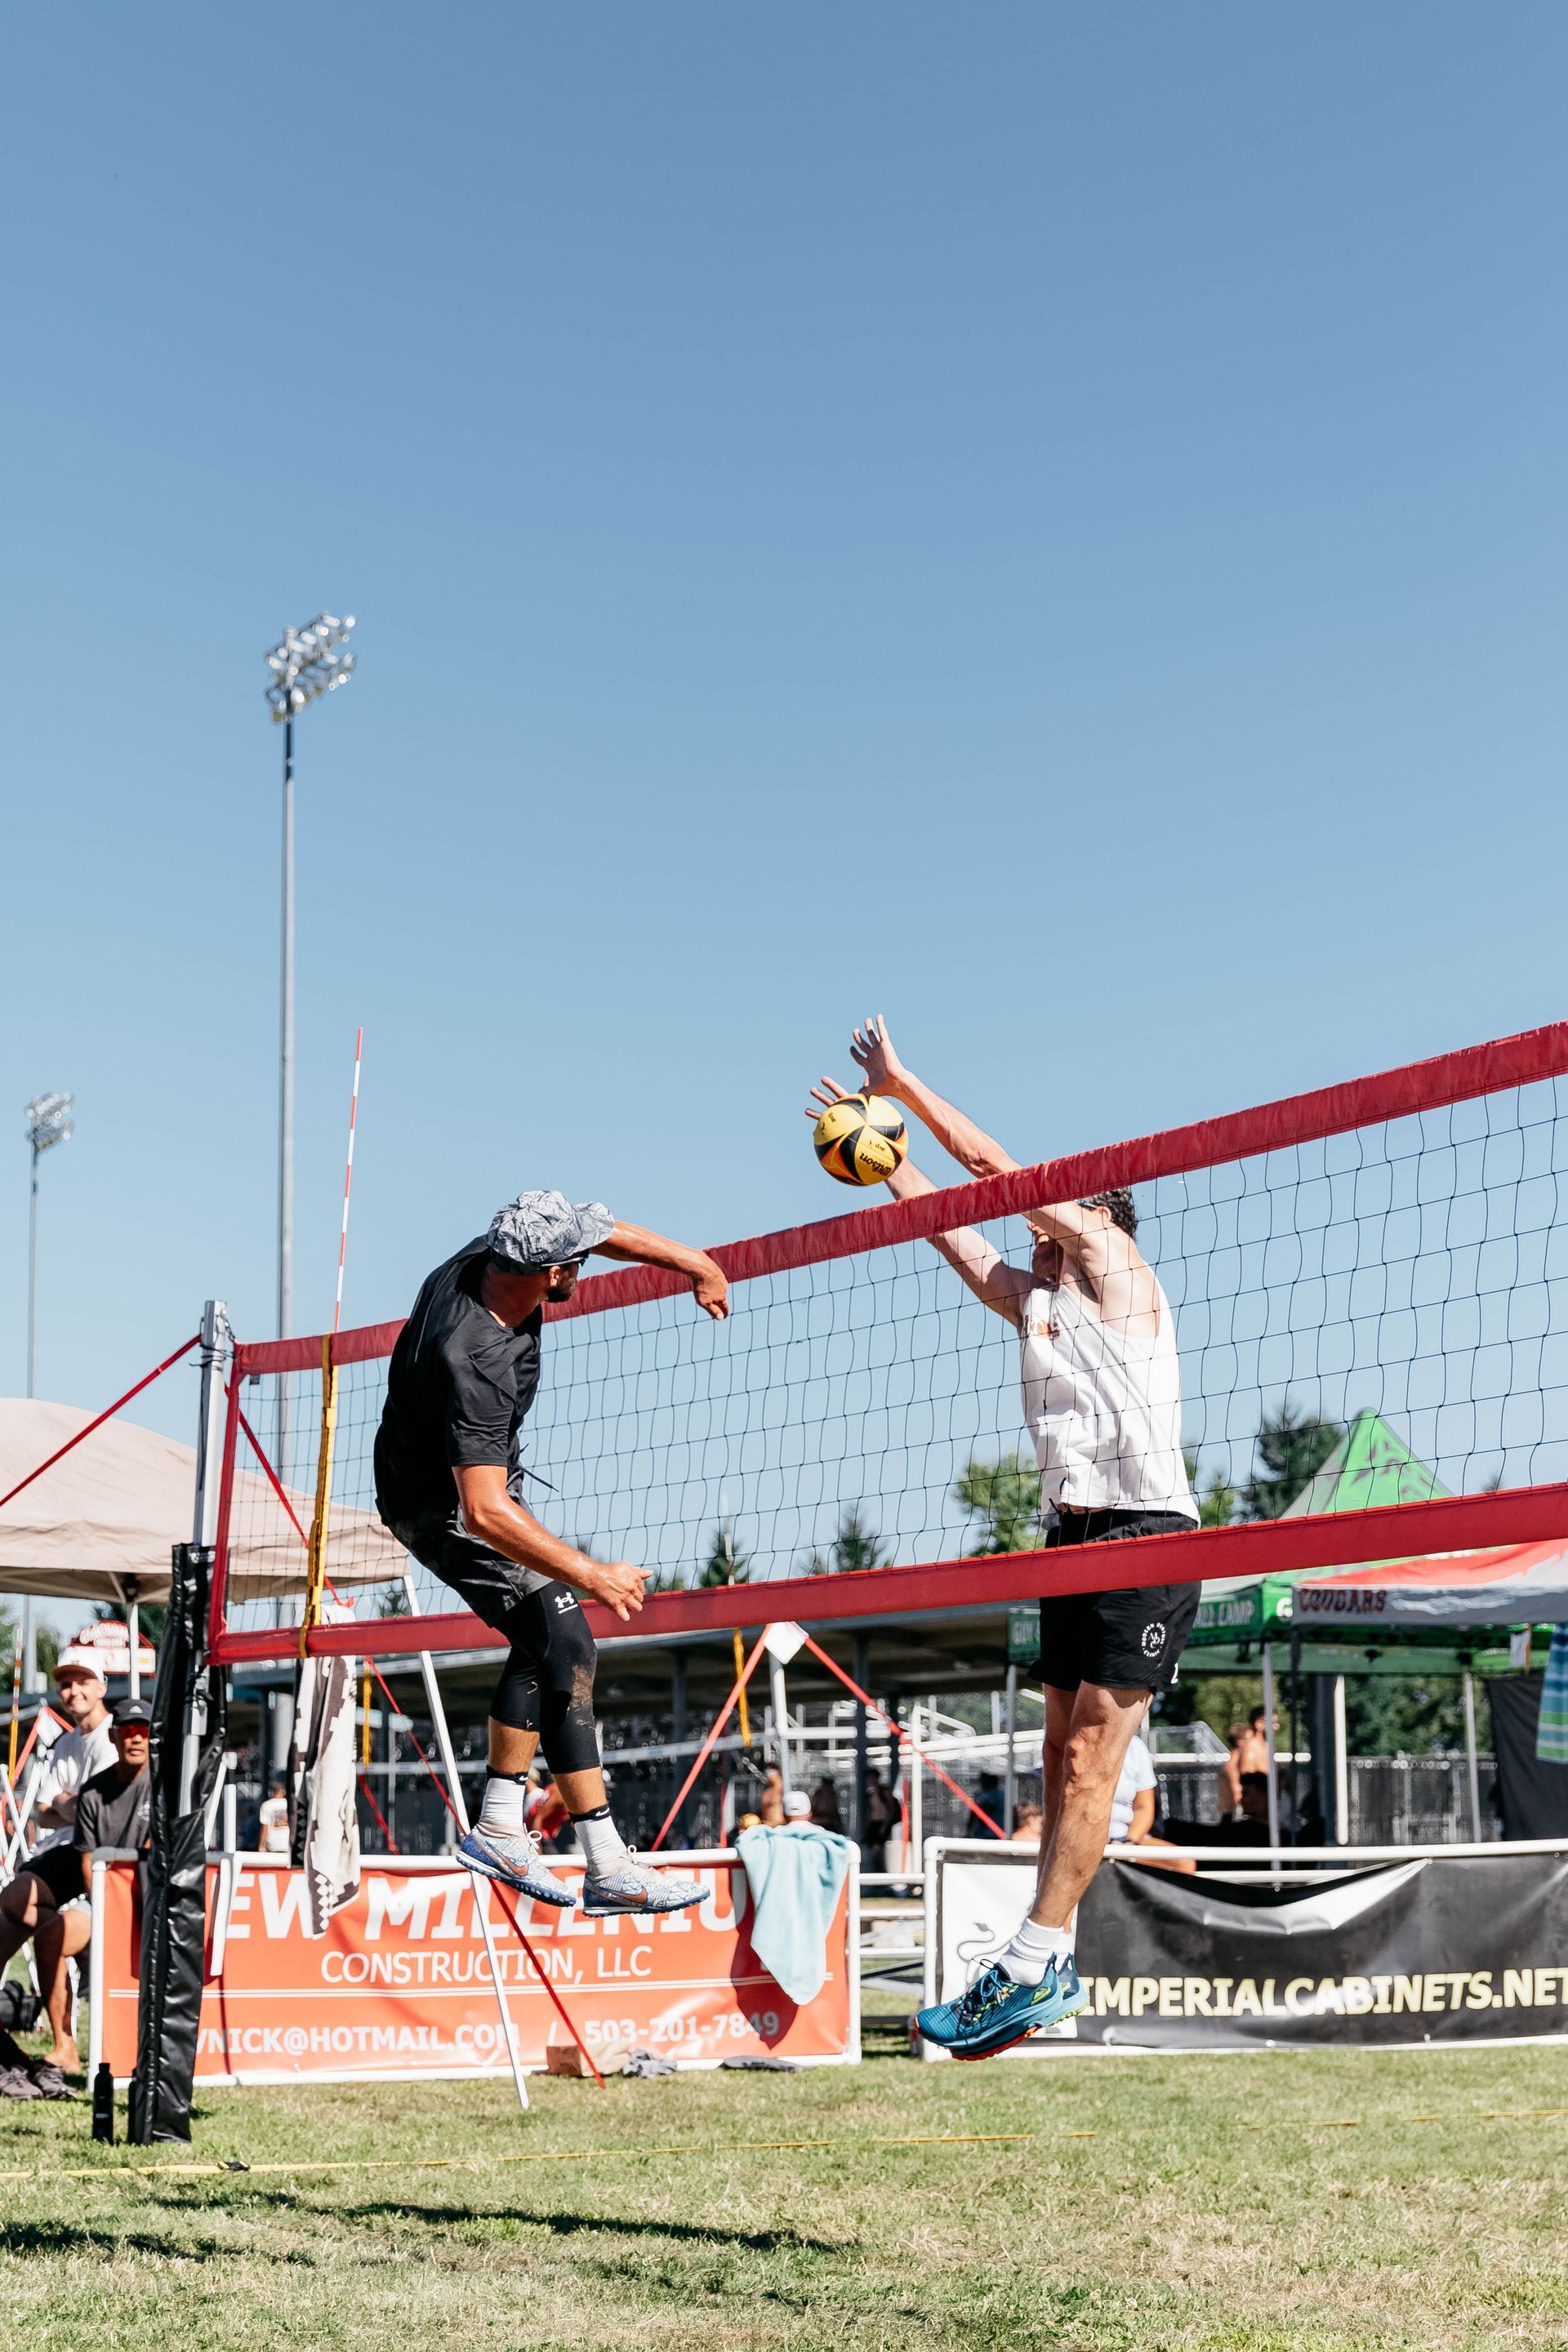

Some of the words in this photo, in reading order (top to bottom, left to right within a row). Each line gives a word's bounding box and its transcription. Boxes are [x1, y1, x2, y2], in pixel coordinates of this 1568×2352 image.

[859, 1152, 892, 1176] Wilson
[1298, 1588, 1388, 1614] COUGARS
[209, 1873, 314, 1939] EW
[320, 1948, 584, 1985] CONSTRUCTION,
[597, 1944, 653, 1979] LLC
[584, 2011, 781, 2044] 503-201-7849
